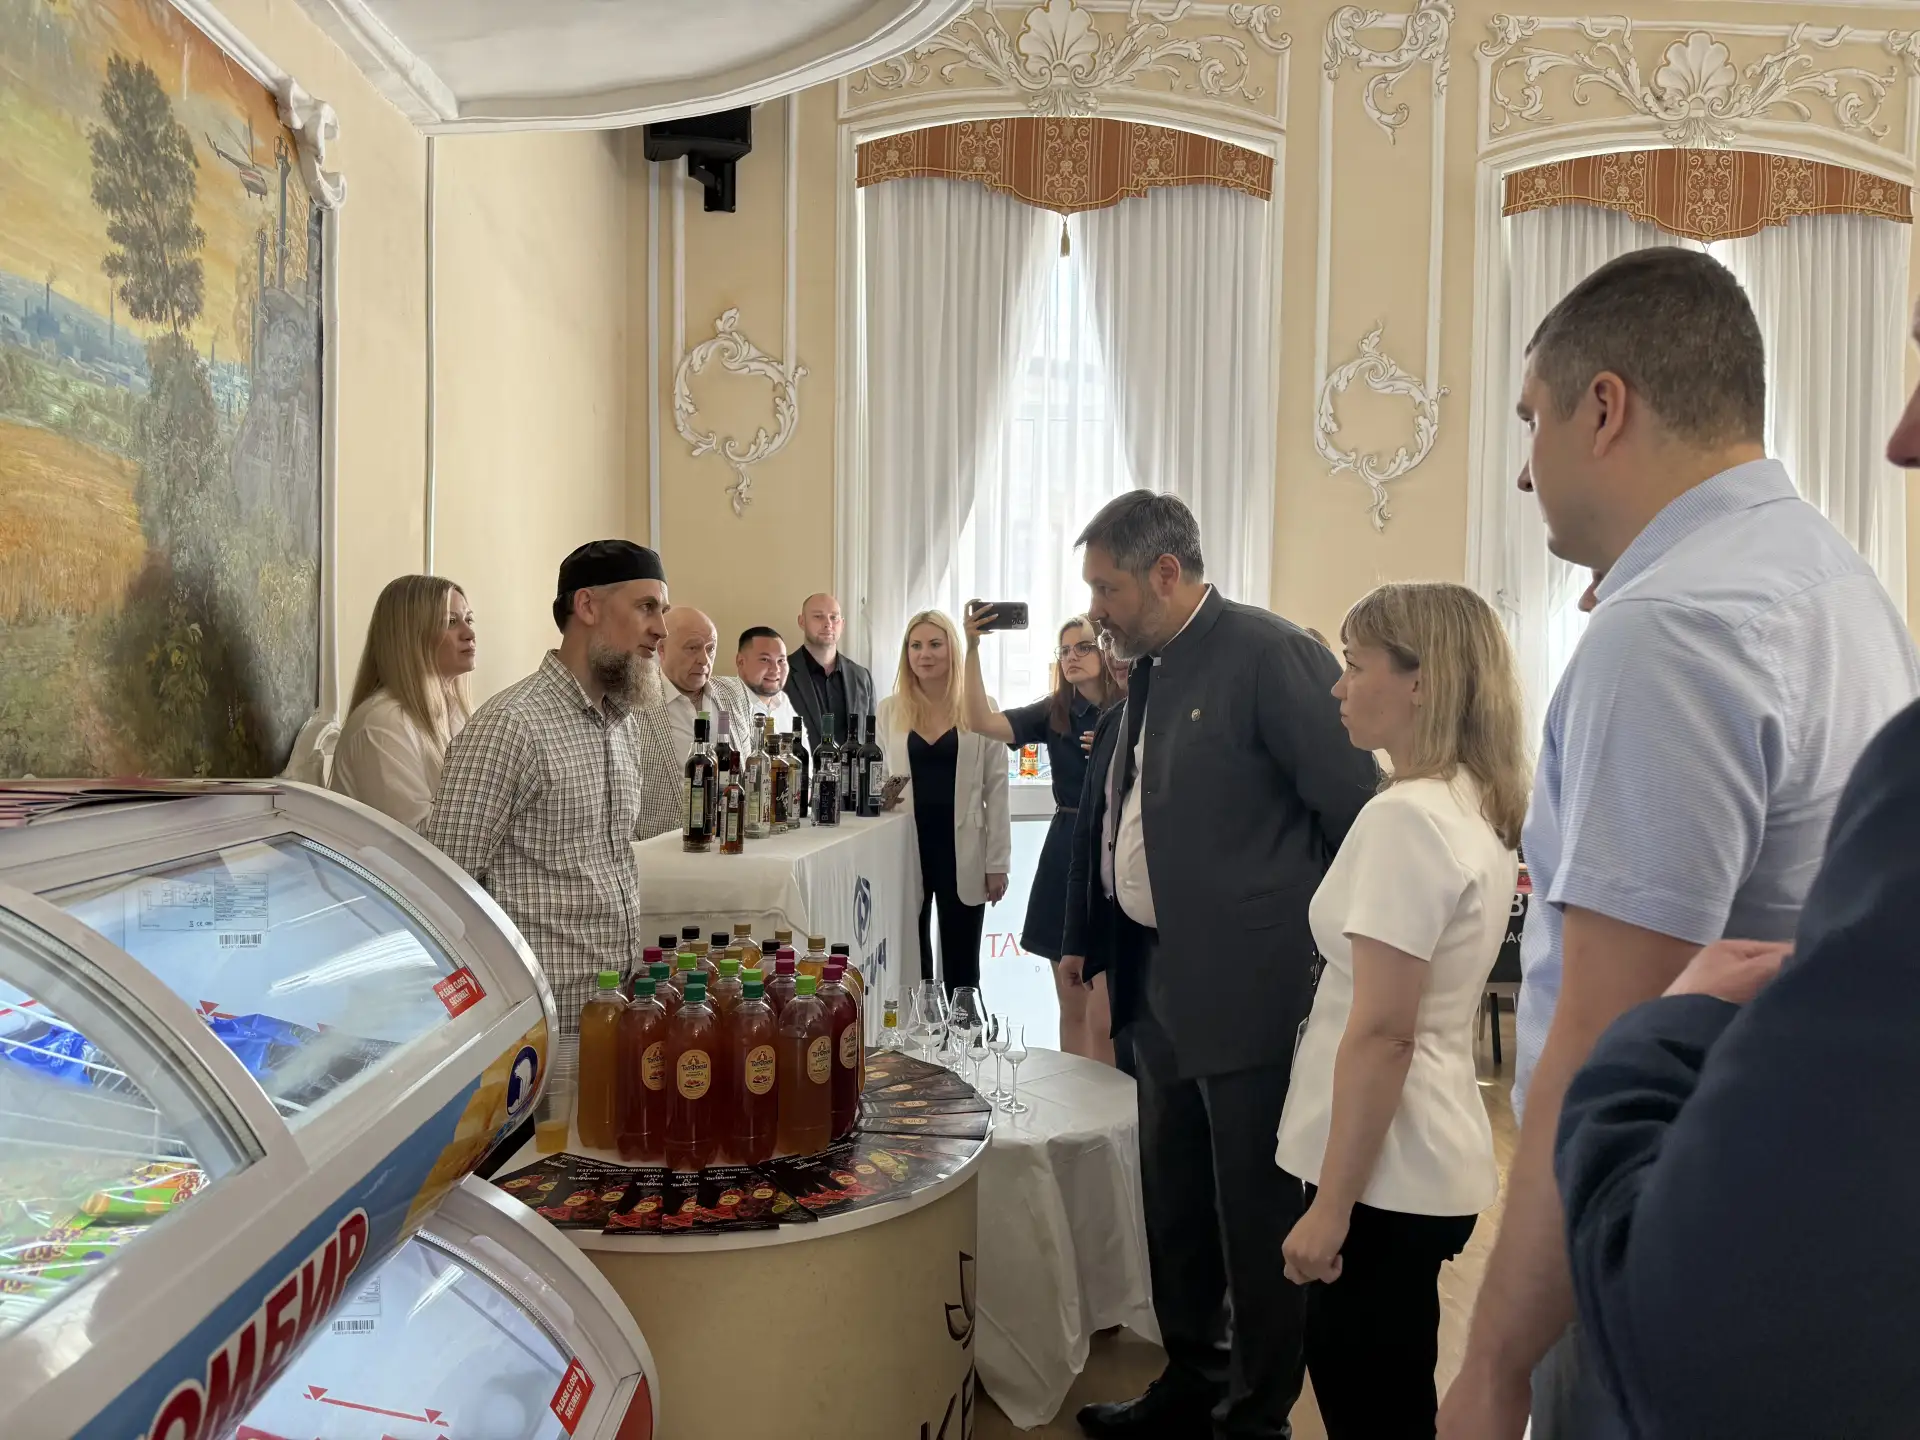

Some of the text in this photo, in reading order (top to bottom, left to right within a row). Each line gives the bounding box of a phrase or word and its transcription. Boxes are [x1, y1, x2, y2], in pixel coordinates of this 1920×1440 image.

[985, 932, 1029, 958] TA
[438, 976, 468, 1000] PLEASE CLOSE
[555, 1371, 579, 1415] PLEASE CLOSE
[564, 1385, 582, 1420] SECURELY
